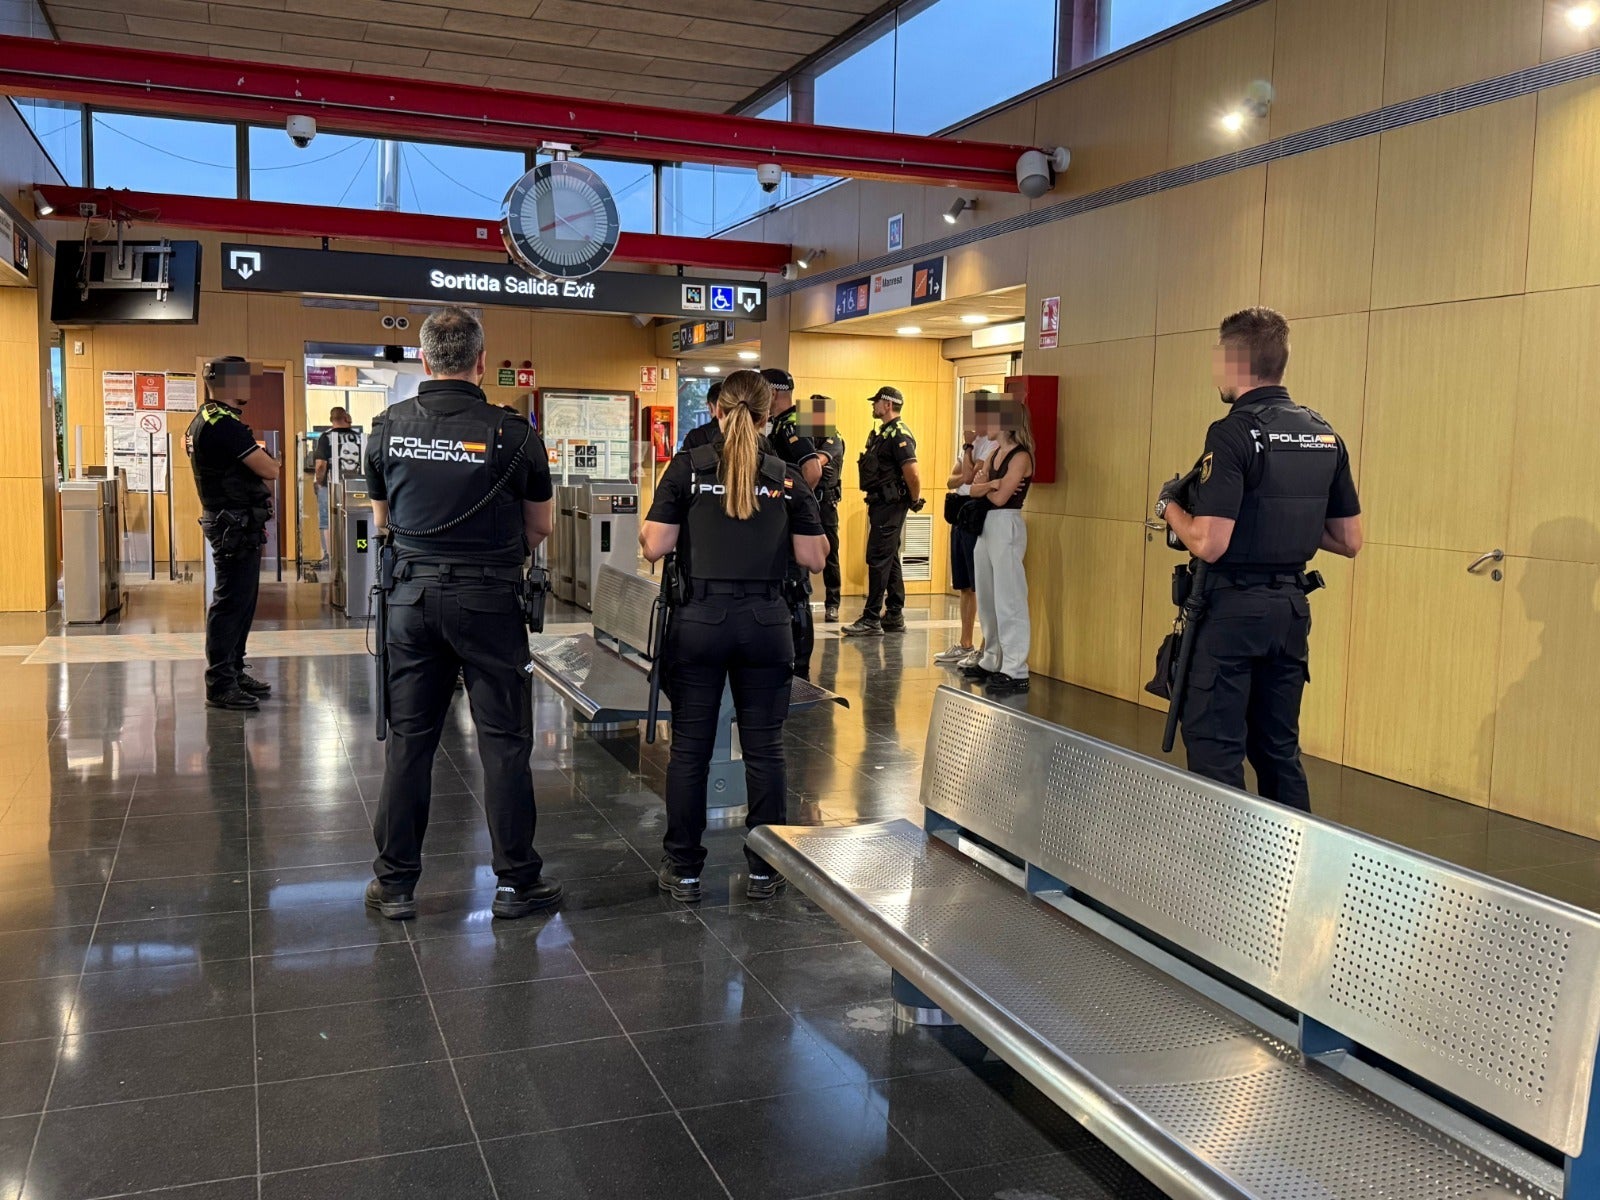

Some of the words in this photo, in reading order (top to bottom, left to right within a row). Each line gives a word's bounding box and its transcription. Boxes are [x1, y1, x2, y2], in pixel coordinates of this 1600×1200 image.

[430, 270, 500, 292] Sortida
[505, 276, 558, 296] Salida
[563, 281, 596, 298] Exit
[883, 276, 903, 288] Manresa
[389, 436, 466, 451] POLICIA
[1268, 433, 1323, 443] POLICIA
[389, 447, 485, 464] NACIONAL
[699, 484, 770, 496] POIA
